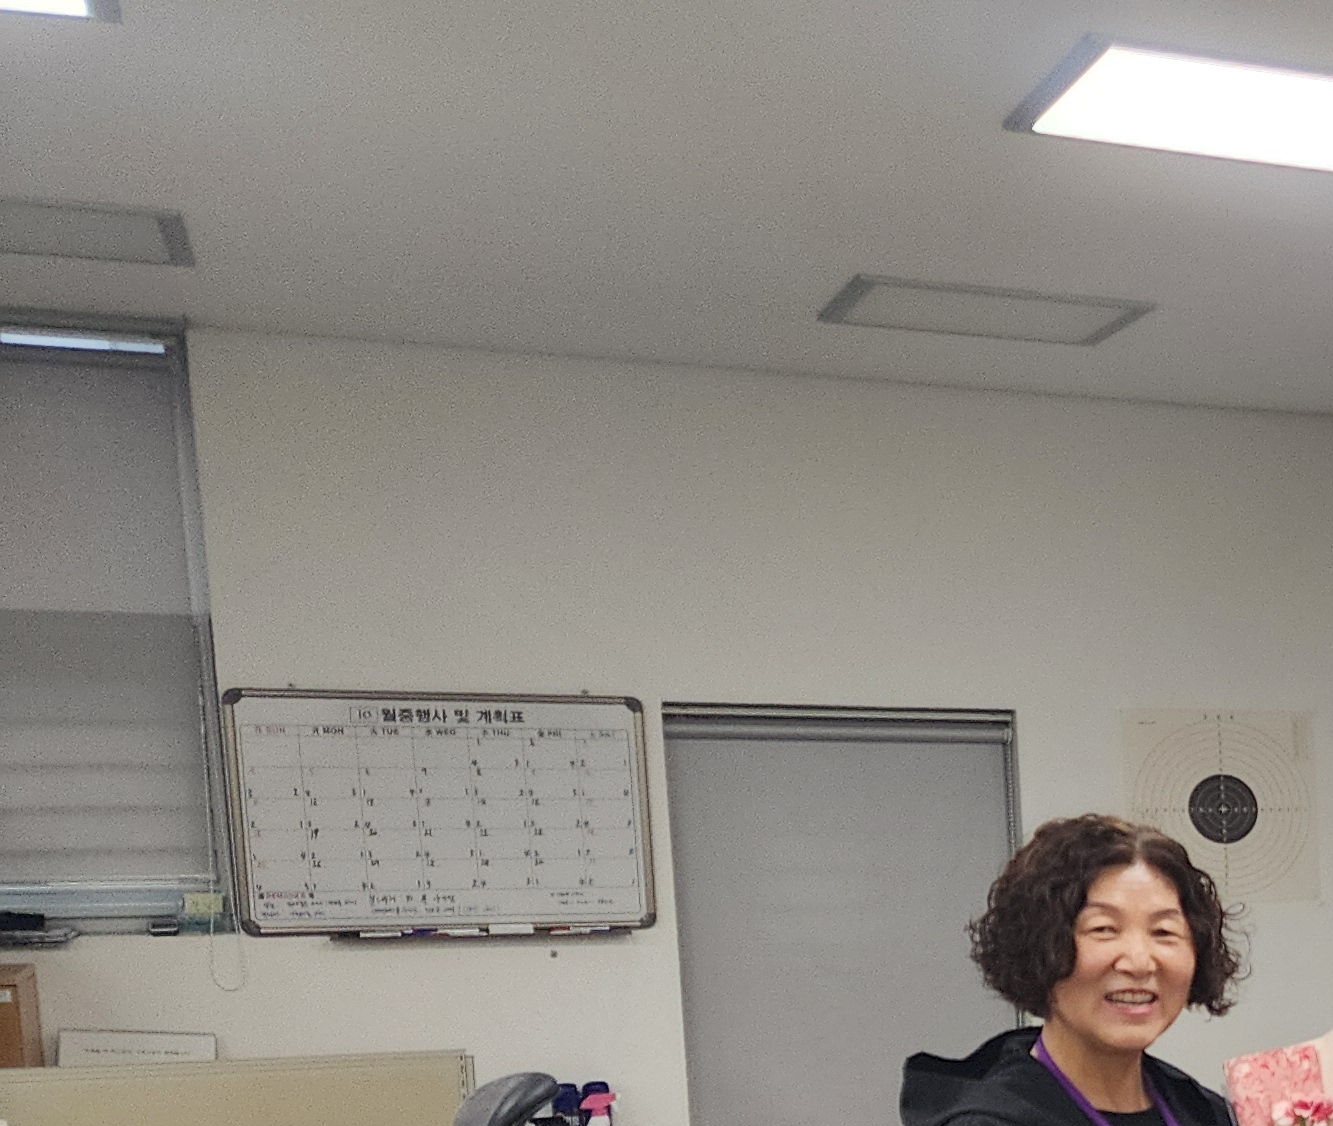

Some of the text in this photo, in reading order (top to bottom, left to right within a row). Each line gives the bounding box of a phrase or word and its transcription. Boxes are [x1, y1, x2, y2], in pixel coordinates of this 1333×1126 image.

[381, 708, 525, 724] 월중행사 및 계획표
